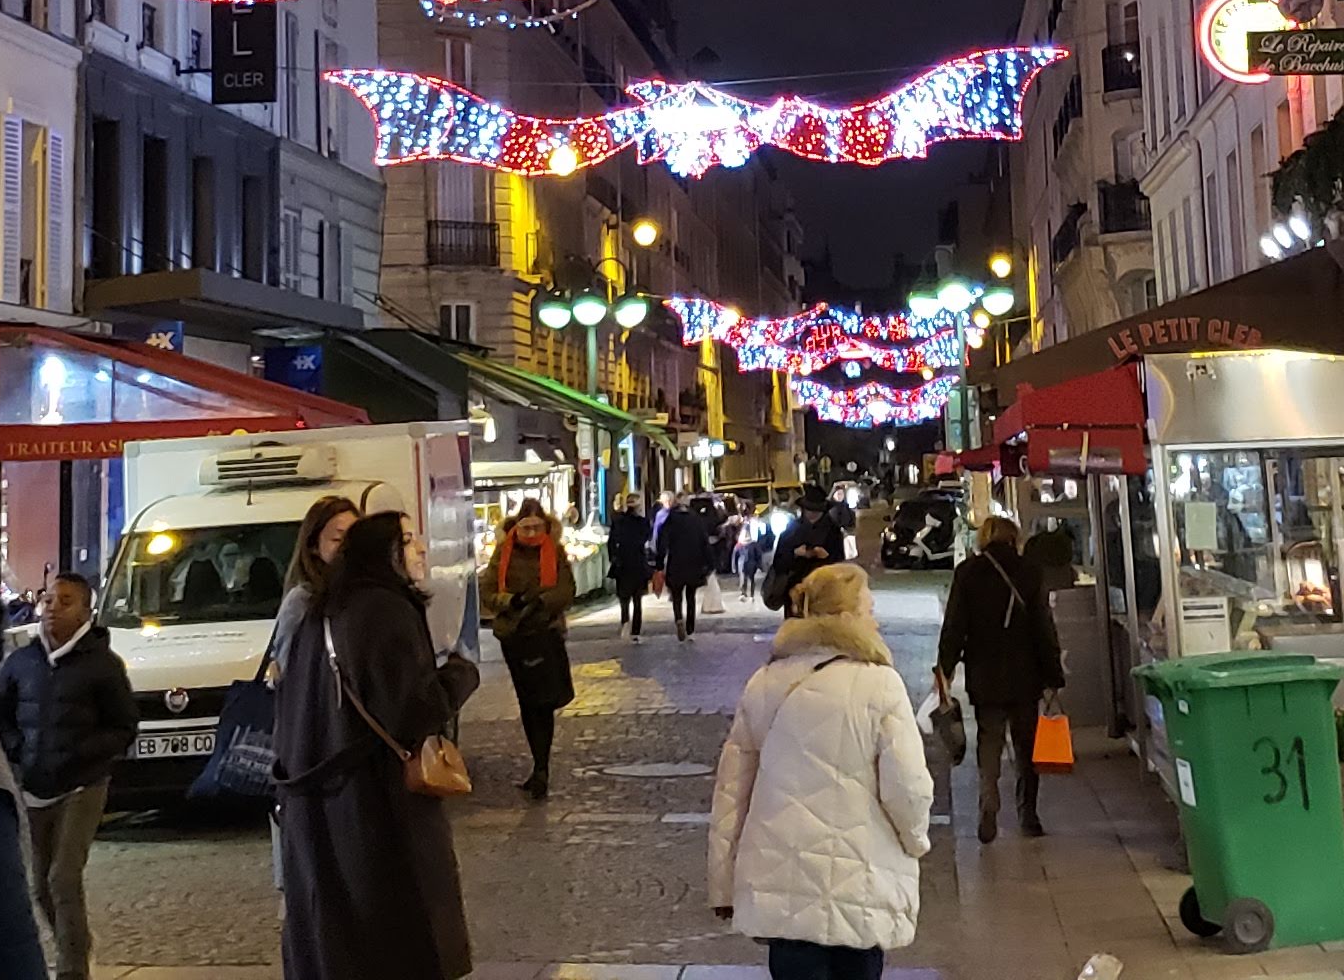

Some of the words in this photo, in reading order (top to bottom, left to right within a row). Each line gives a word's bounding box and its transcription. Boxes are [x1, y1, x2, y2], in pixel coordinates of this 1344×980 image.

[223, 72, 264, 88] CLER
[1108, 329, 1139, 360] LE
[1139, 317, 1201, 348] PETIT
[7, 441, 93, 457] TRAITEUR
[139, 739, 156, 754] EB
[1252, 735, 1311, 812] 31
